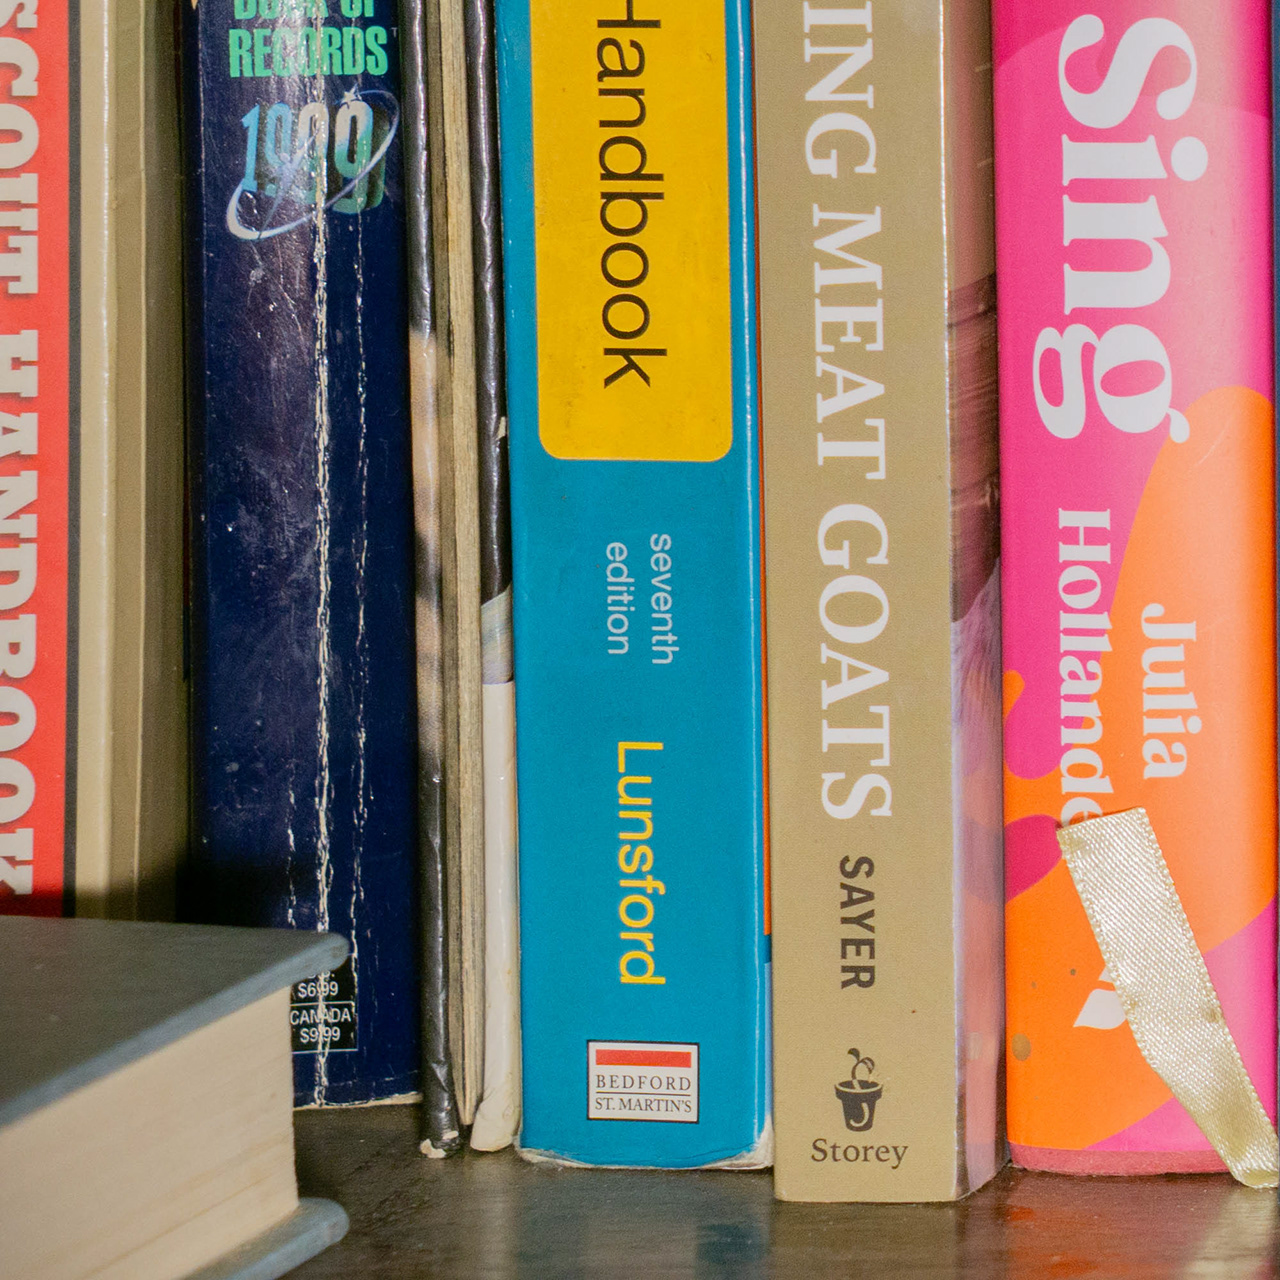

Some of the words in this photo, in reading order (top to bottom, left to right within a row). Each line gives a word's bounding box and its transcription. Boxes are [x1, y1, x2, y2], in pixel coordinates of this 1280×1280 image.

[228, 26, 388, 78] RECORDS
[241, 99, 376, 214] 1999
[1033, 14, 1209, 443] Sing
[812, 204, 887, 480] MEAT
[606, 541, 635, 656] edition
[649, 533, 680, 665] seventh
[817, 503, 892, 821] GOATS
[1058, 508, 1115, 826] Hollande
[1140, 602, 1202, 780] Julia
[617, 741, 666, 985] Lunsford
[839, 854, 876, 990] SAYER
[290, 1008, 352, 1025] CANADA
[300, 1026, 341, 1043] $999
[595, 1074, 692, 1091] BEDFORD
[595, 1097, 616, 1111] ST.
[618, 1097, 692, 1113] MARTIN'S
[811, 1138, 909, 1170] Storey
